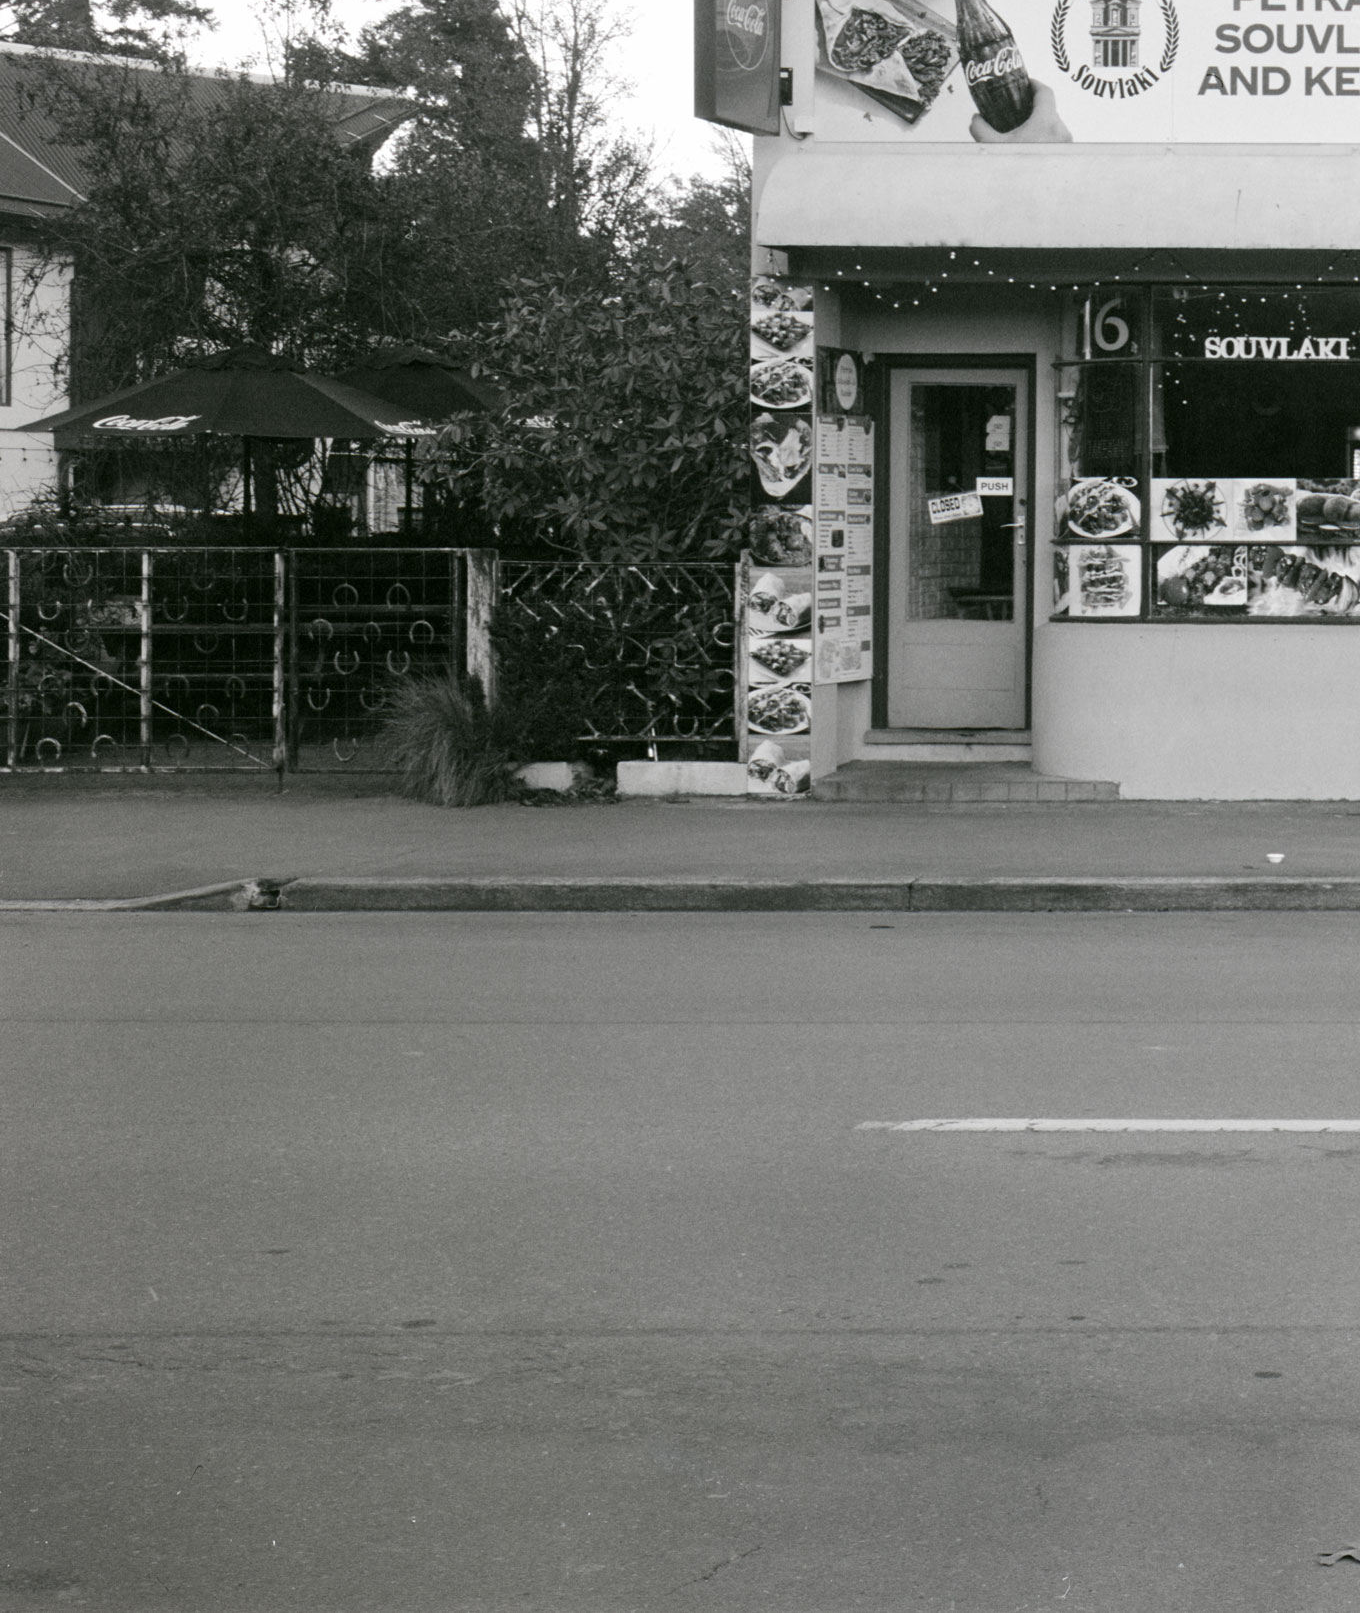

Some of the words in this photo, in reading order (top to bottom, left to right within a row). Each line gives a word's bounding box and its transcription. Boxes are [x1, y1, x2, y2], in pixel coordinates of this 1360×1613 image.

[965, 47, 1022, 87] Coca-Cola
[1071, 64, 1160, 99] Souvlaki
[1197, 66, 1291, 96] AND
[1083, 297, 1130, 360] 16
[1204, 336, 1350, 360] SOUVLAKI
[981, 482, 1009, 491] PUSH
[931, 496, 960, 515] CLOSED
